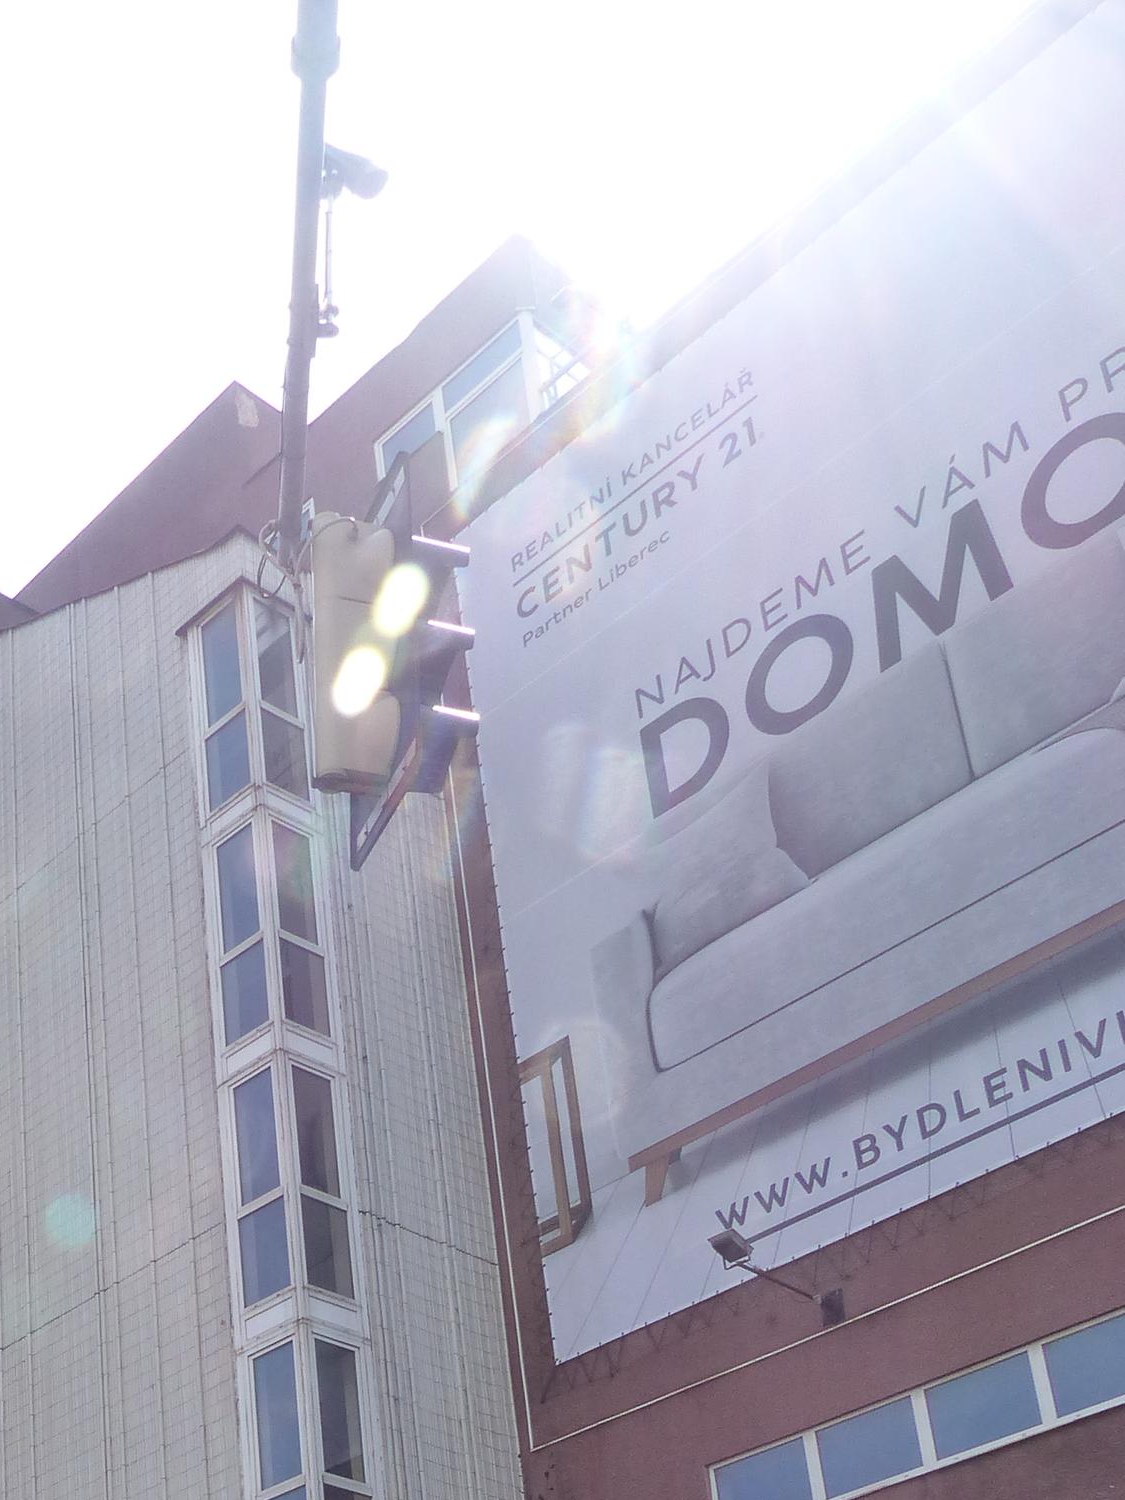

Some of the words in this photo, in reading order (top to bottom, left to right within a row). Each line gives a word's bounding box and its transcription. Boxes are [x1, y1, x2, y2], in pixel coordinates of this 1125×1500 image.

[510, 477, 613, 572] REALITNÍ
[622, 366, 754, 486] KANCELÁŘ
[516, 453, 705, 618] CENTURY
[718, 416, 757, 468] 21
[634, 530, 872, 719] NAJDEME
[894, 421, 1030, 528] VÁM
[523, 586, 593, 648] Partner
[598, 531, 670, 591] Liberec
